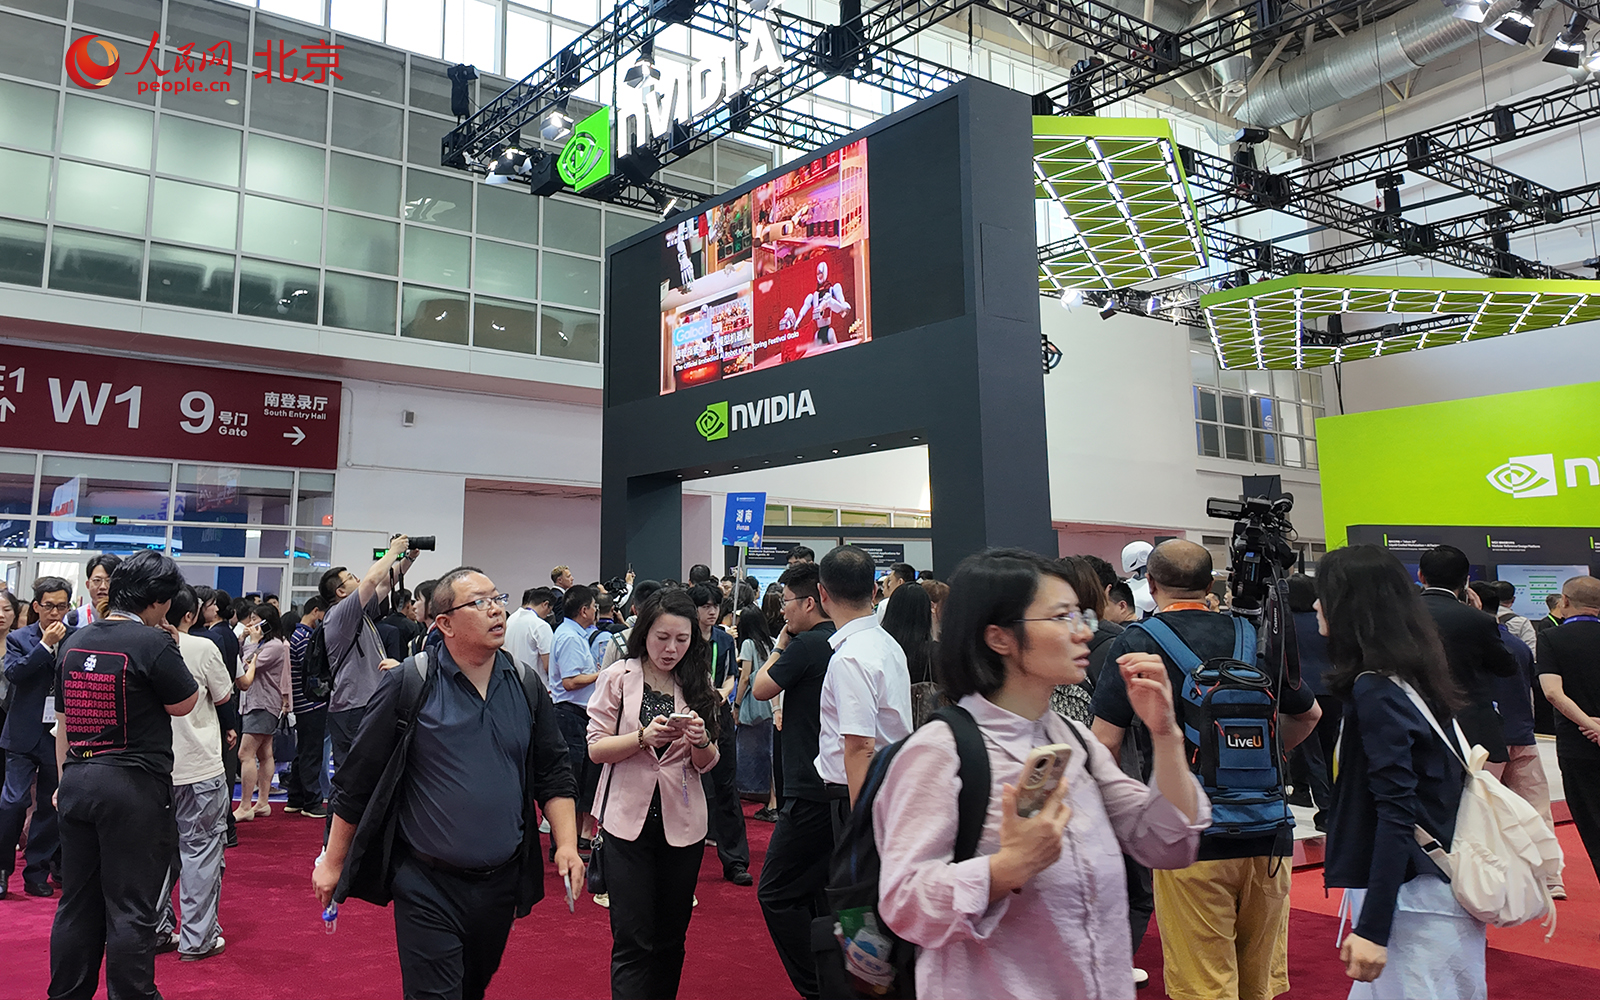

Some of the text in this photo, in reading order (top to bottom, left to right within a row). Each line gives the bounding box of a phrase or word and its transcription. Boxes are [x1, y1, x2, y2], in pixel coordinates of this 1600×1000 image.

[48, 377, 142, 429] W1
[264, 391, 328, 411] 南登录厅
[179, 390, 215, 434] 9
[218, 411, 248, 427] 号门
[263, 408, 326, 420] South Entry Hall
[218, 426, 248, 437] Gate
[736, 509, 752, 523] 湖南
[1227, 733, 1262, 747] LiveU
